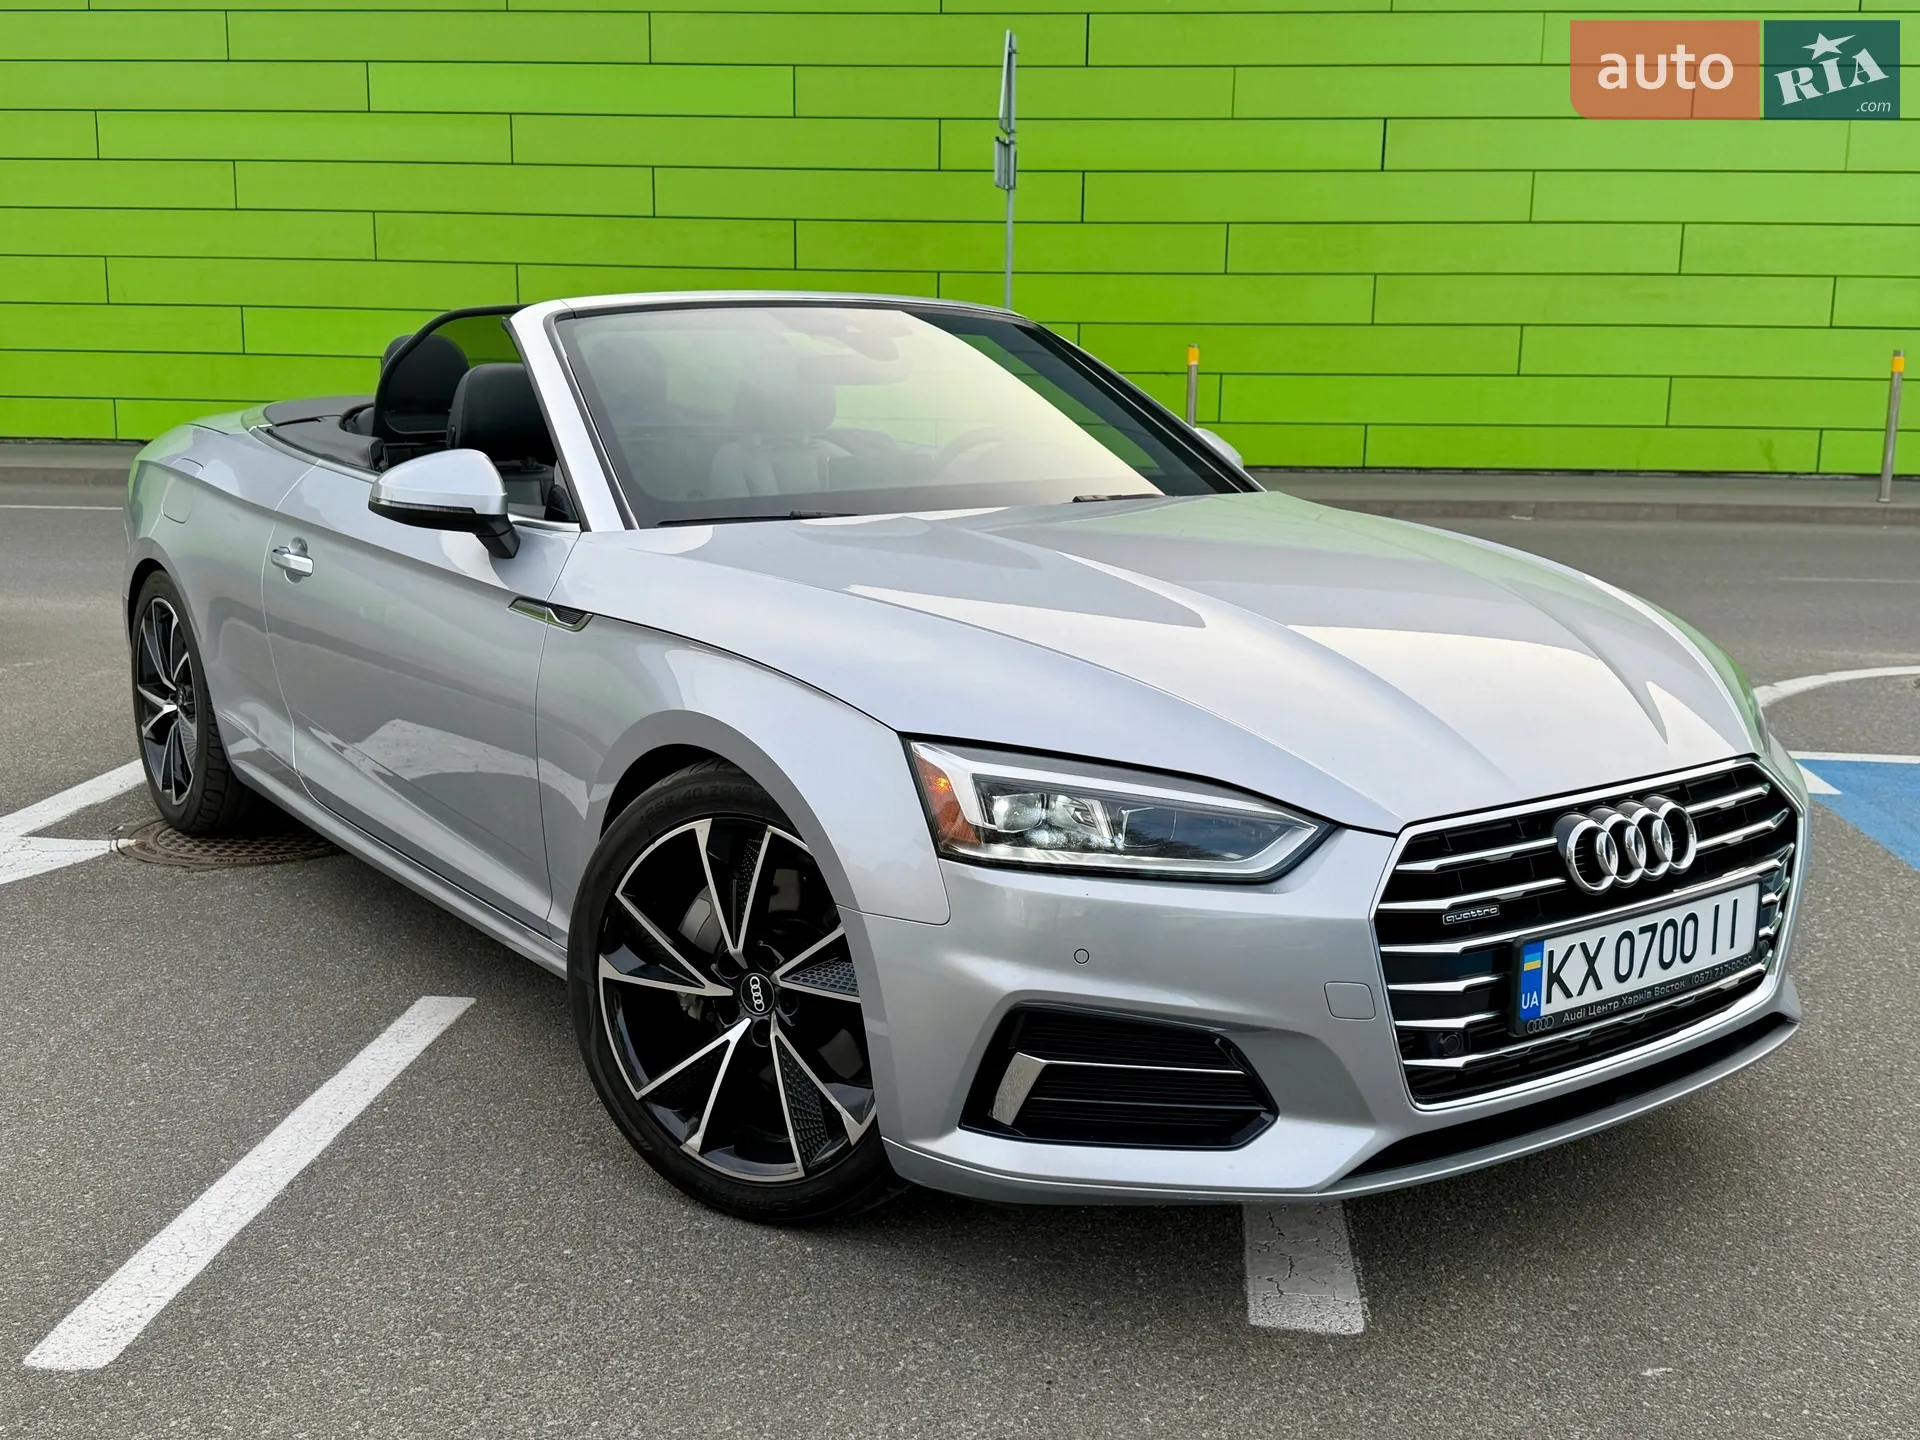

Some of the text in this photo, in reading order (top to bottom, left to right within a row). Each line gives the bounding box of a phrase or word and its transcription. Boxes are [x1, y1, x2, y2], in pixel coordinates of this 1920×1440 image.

[1446, 907, 1498, 923] quattro
[1545, 936, 1606, 1005] KX
[1614, 912, 1699, 984] 0700
[1521, 990, 1540, 1010] UA
[1562, 1008, 1587, 1023] Audi
[1588, 1001, 1620, 1016] Центр
[1621, 989, 1652, 1006] Харків
[1654, 980, 1686, 997] Восток
